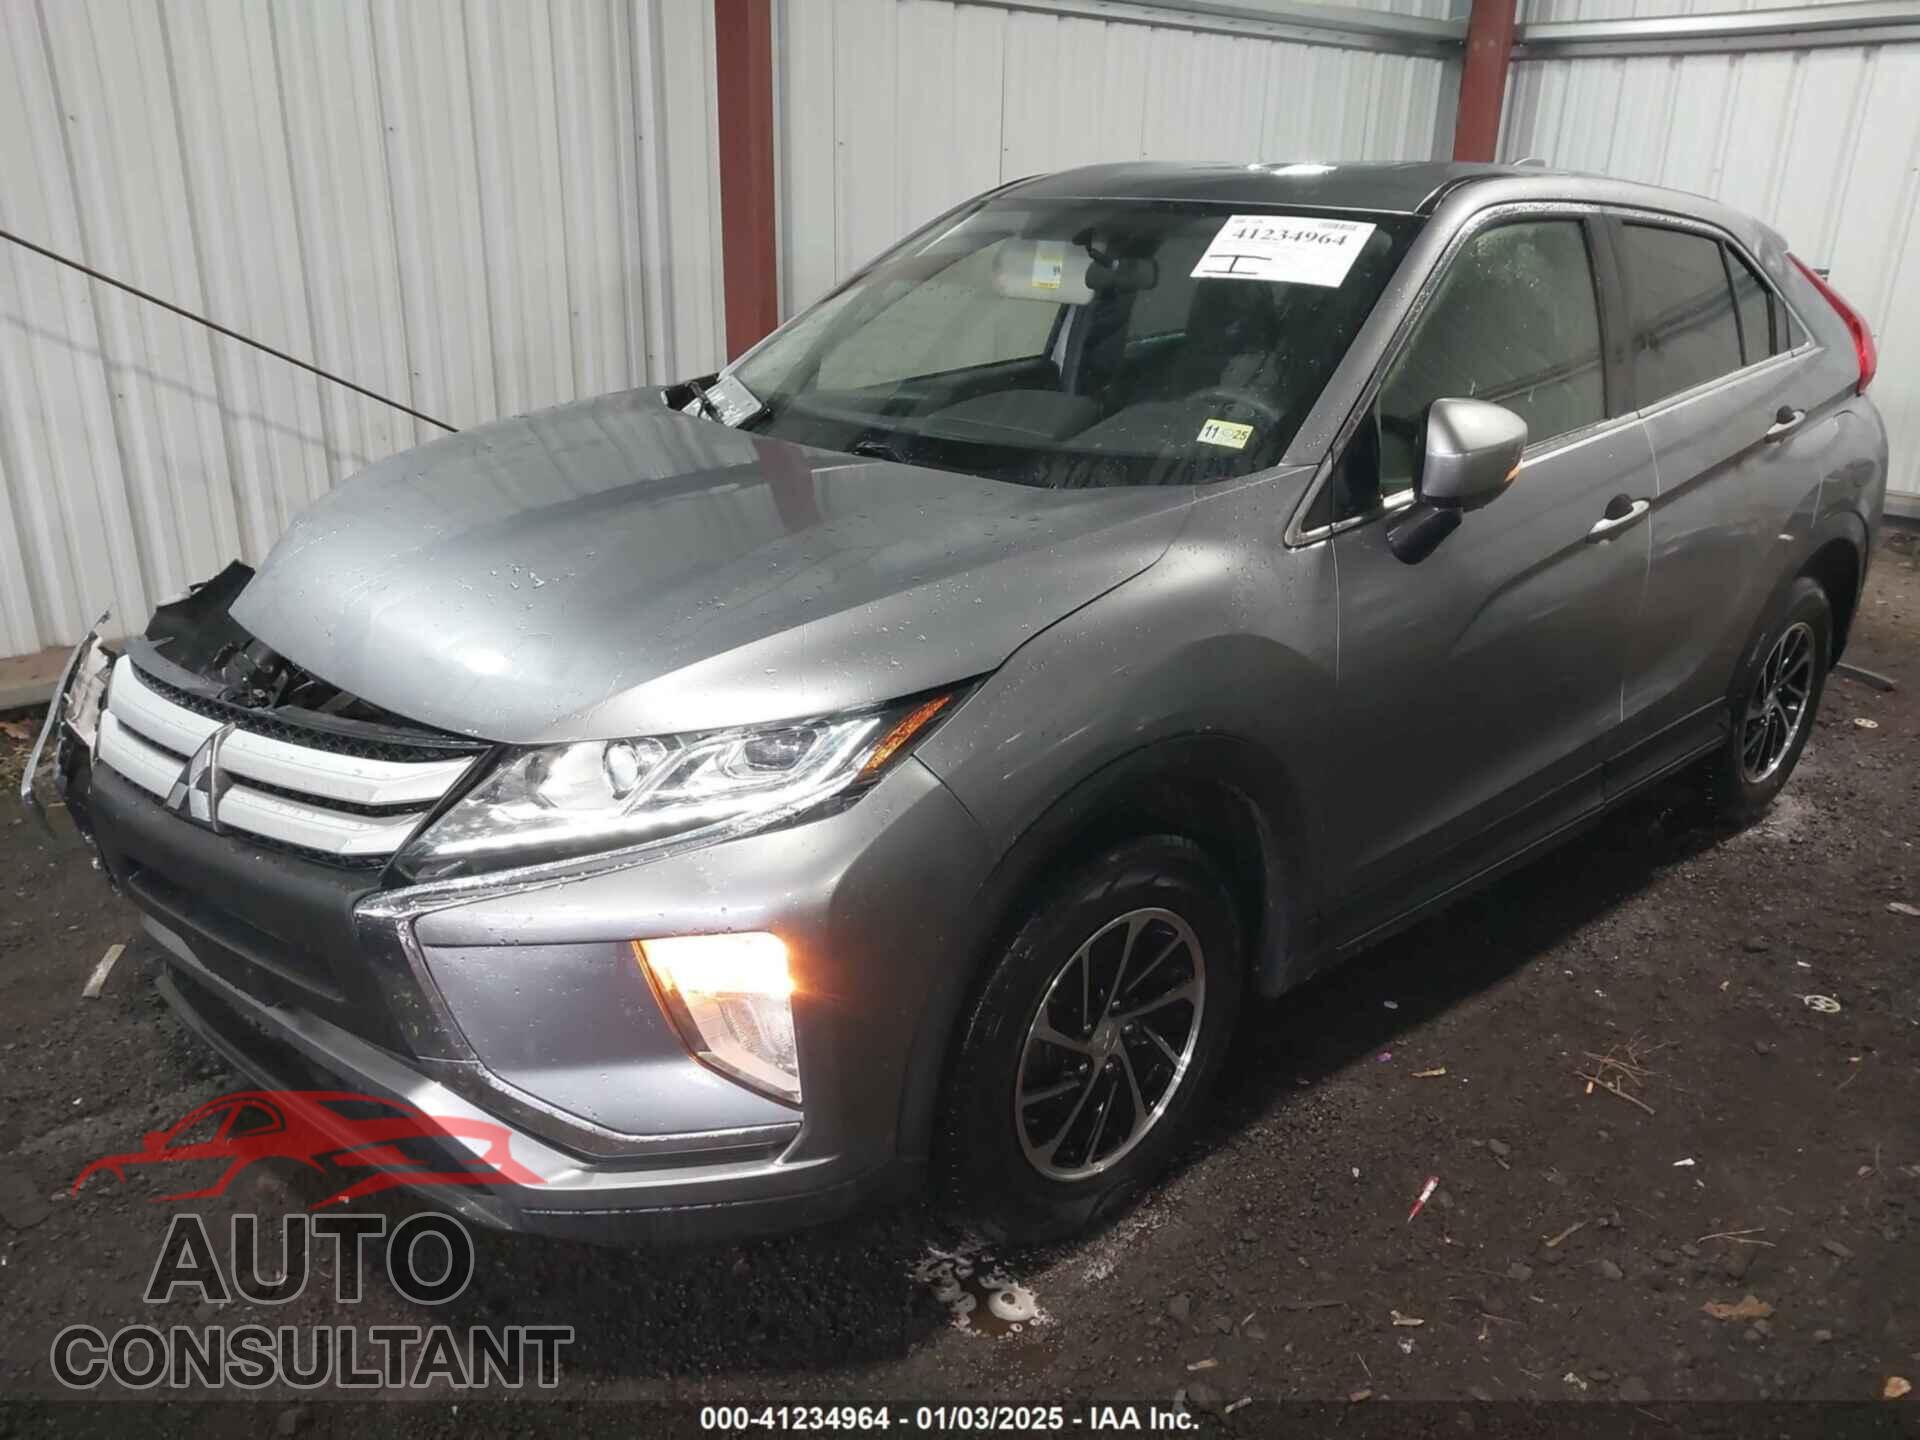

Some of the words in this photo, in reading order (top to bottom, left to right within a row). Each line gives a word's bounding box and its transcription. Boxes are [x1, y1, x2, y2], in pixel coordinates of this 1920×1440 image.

[1231, 227, 1349, 246] 41234964
[1205, 424, 1220, 439] 11
[1232, 429, 1249, 440] 25
